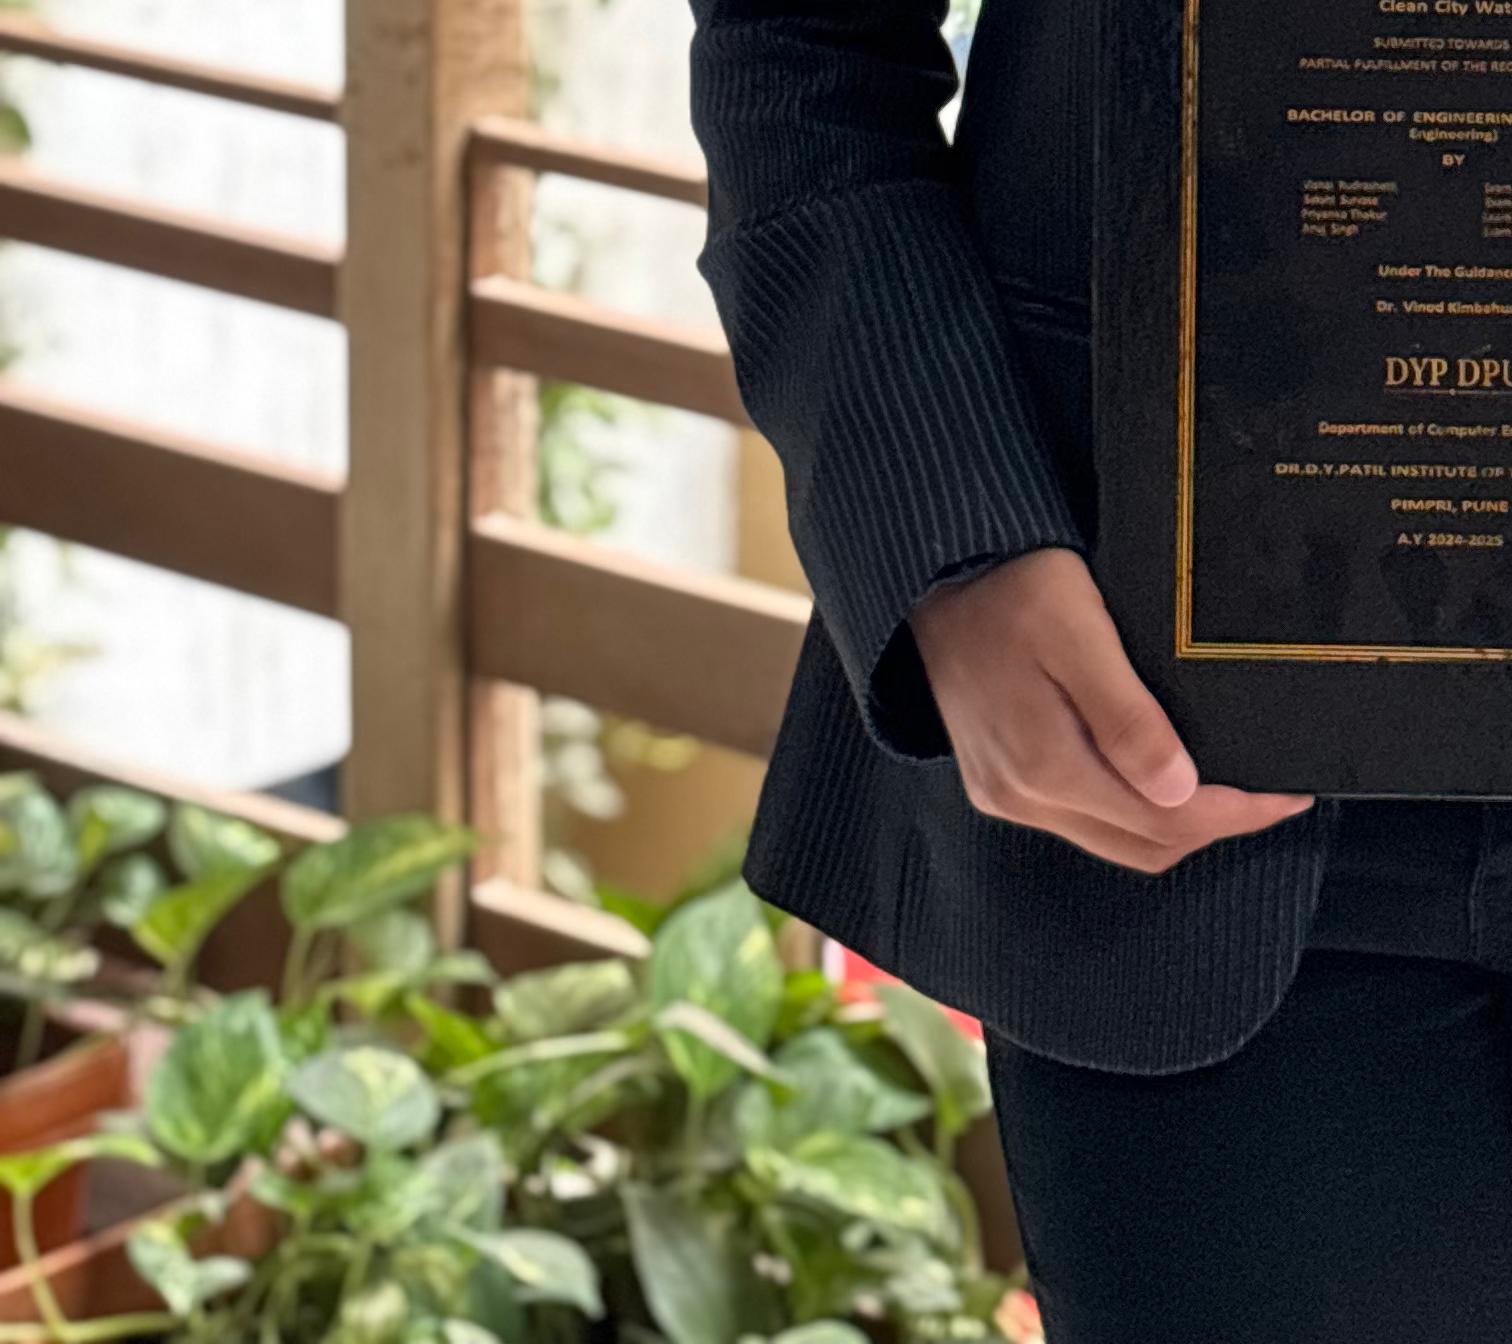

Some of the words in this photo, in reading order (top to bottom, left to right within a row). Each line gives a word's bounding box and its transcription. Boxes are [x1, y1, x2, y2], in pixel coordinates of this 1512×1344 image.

[1435, 0, 1469, 16] City
[1373, 36, 1445, 50] SUBMITTED
[1448, 37, 1511, 51] TOWARDS
[1299, 57, 1350, 70] PARTIAL
[1441, 60, 1460, 72] OF
[1462, 60, 1487, 73] THE
[1286, 109, 1376, 123] BACHELOR
[1382, 110, 1406, 123] OF
[1409, 128, 1499, 144] Engineering)
[1441, 154, 1466, 167] BY
[1378, 263, 1421, 278] Under
[1425, 264, 1451, 278] The
[1376, 300, 1398, 313] Dr.
[1402, 300, 1445, 313] Vinod
[1384, 357, 1449, 386] DYP
[1318, 422, 1404, 438] Department
[1408, 422, 1425, 436] of
[1427, 424, 1497, 440] Computer
[1391, 464, 1477, 479] INSTITUTE
[1481, 466, 1505, 479] OF
[1390, 498, 1457, 515] PIMPRI,
[1462, 500, 1509, 513] PUNE
[1428, 533, 1504, 547] 2024-2025
